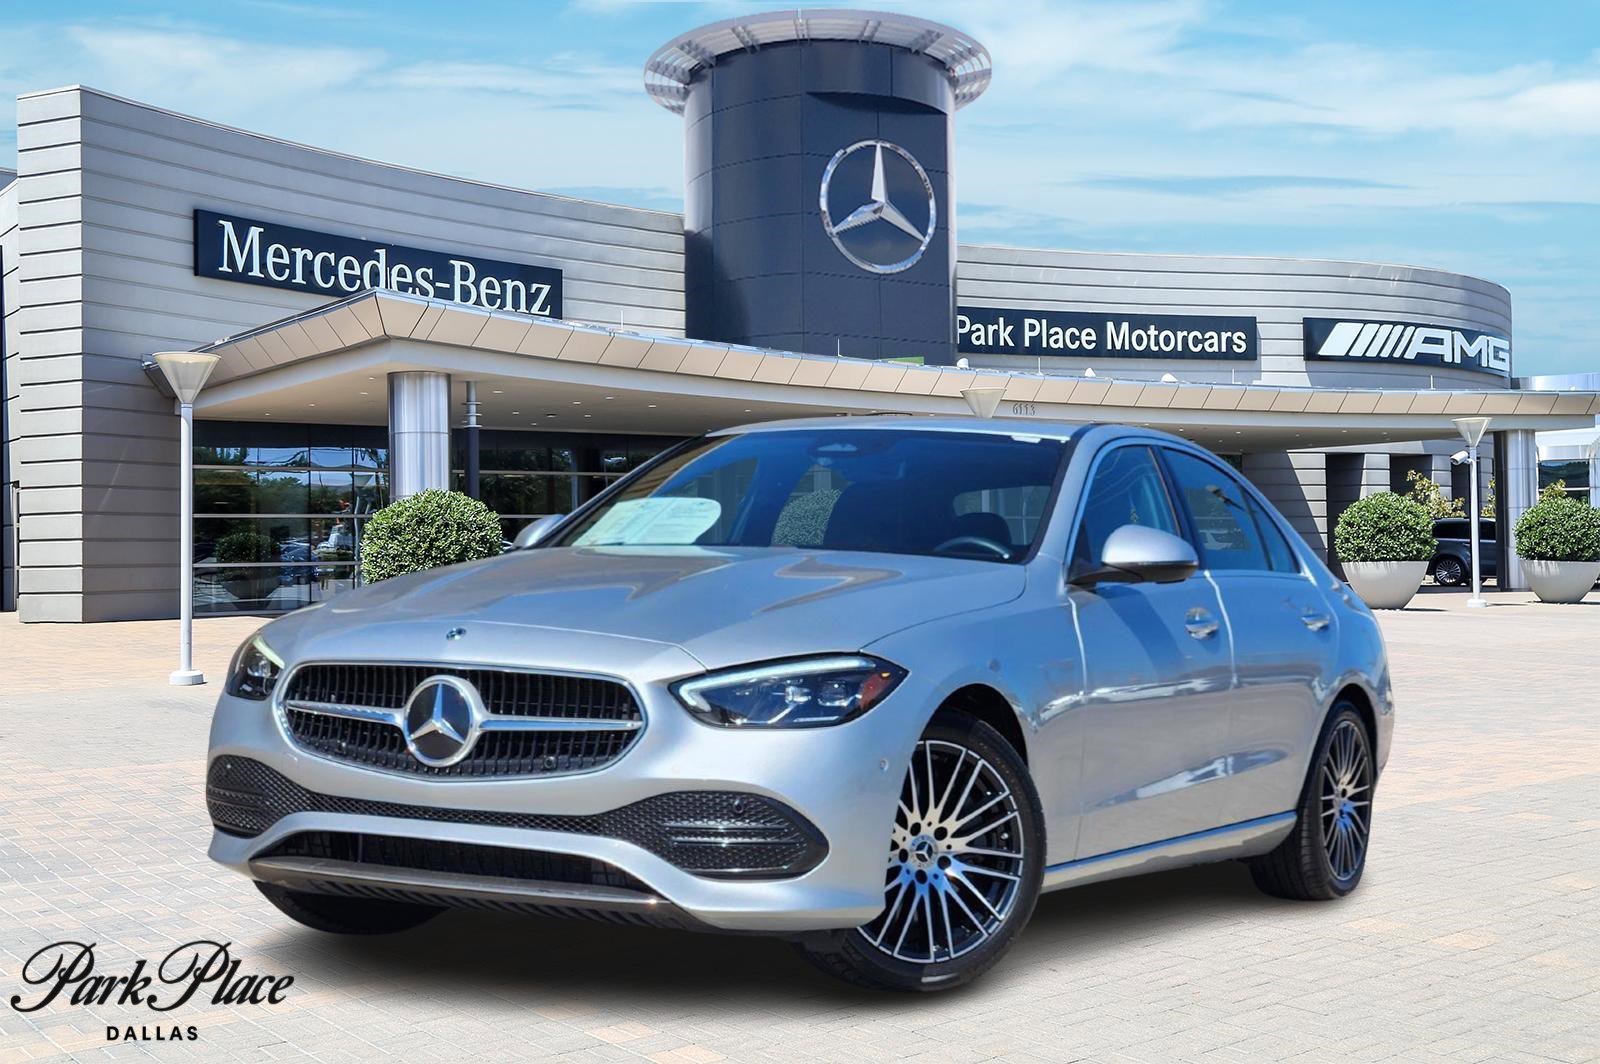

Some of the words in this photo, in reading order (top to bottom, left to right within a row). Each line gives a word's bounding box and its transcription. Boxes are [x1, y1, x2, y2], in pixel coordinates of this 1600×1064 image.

[218, 219, 551, 316] Mercedes-Benz
[957, 315, 1015, 347] Park
[1023, 318, 1097, 350] Place
[1106, 321, 1248, 353] Motorcars
[1404, 326, 1510, 373] AMG
[1012, 402, 1036, 416] 6113
